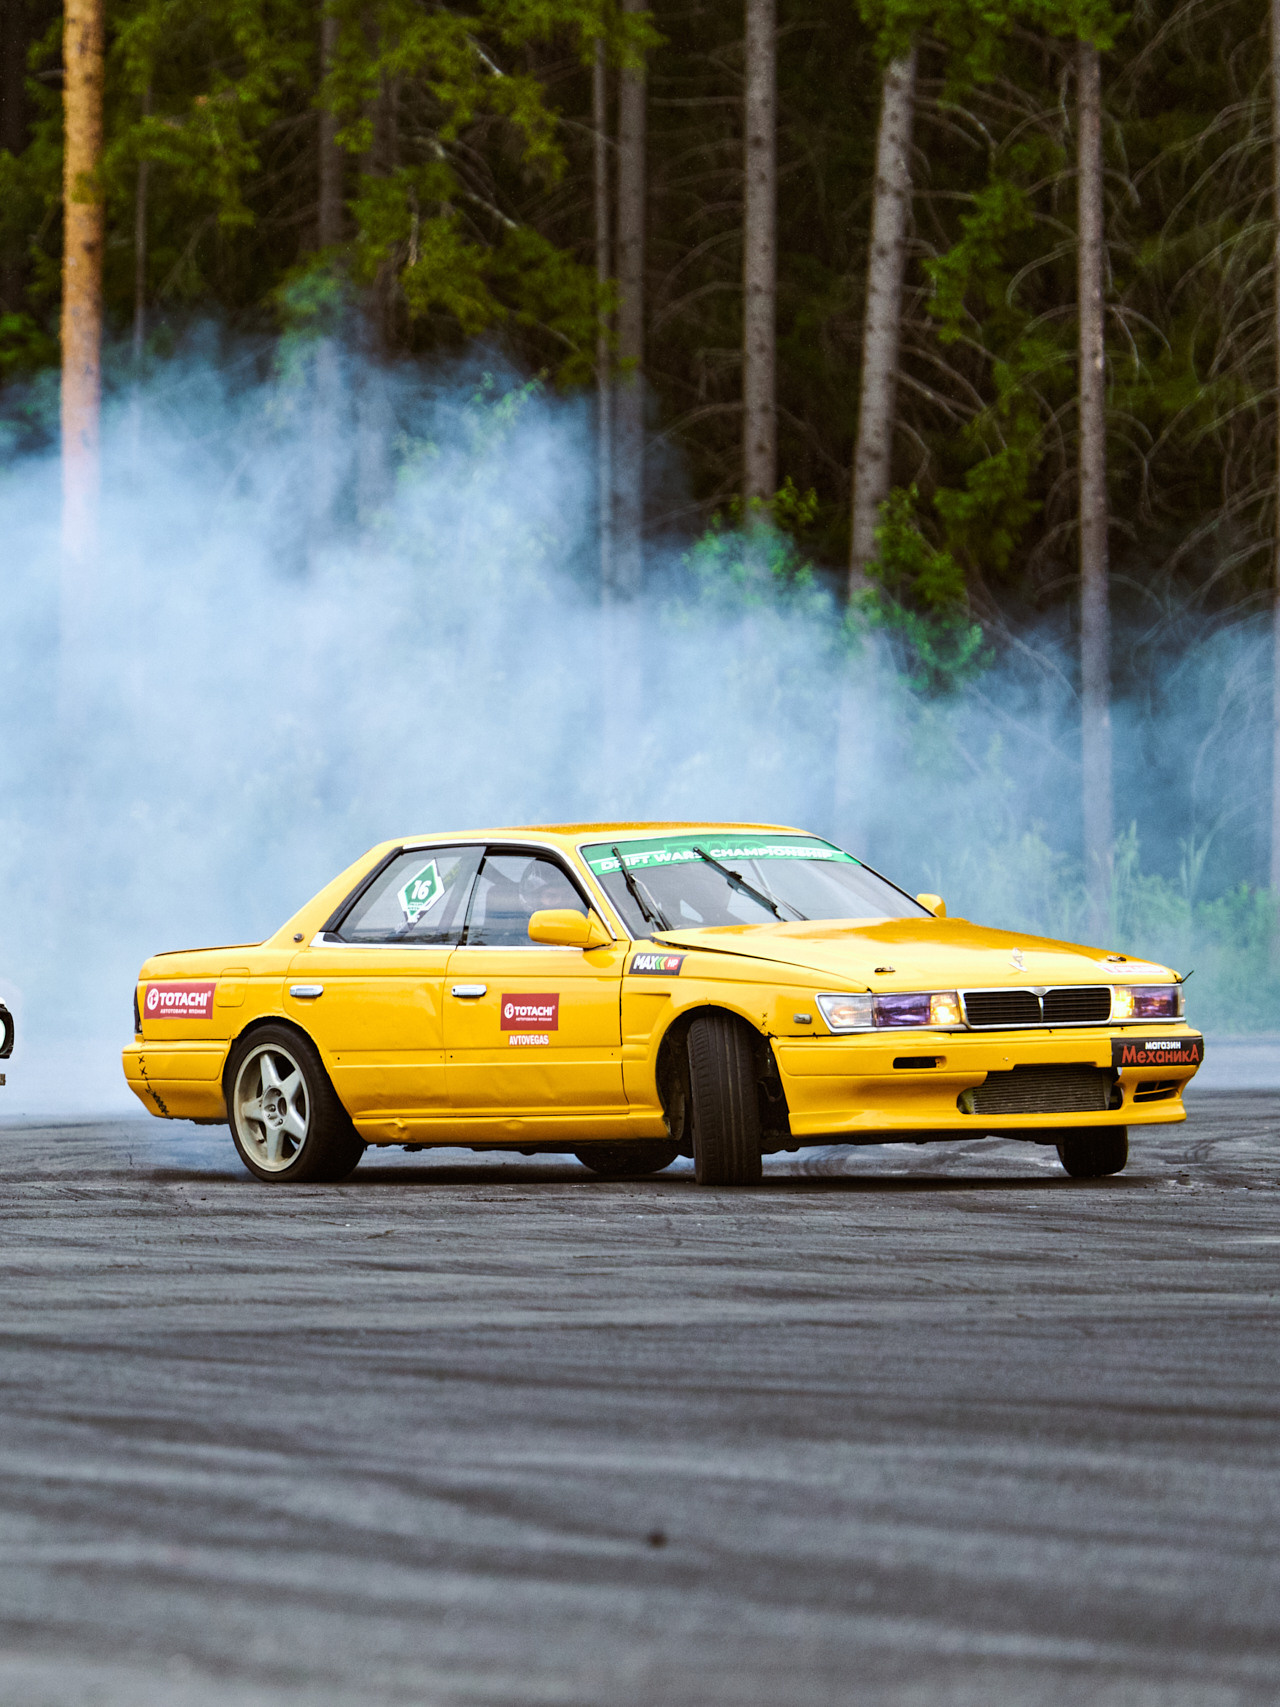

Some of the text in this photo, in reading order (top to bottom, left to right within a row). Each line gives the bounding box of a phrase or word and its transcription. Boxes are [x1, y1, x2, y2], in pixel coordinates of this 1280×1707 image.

[709, 848, 833, 858] CHAMPIONSHIP
[411, 880, 432, 900] 16
[633, 955, 679, 970] MAX HP
[159, 992, 208, 1007] TOTACHI
[514, 1005, 553, 1016] TOTACHI
[509, 1034, 549, 1045] AVTOVEGAS
[1145, 1042, 1181, 1050] магазин
[1121, 1044, 1200, 1064] МеханикА
